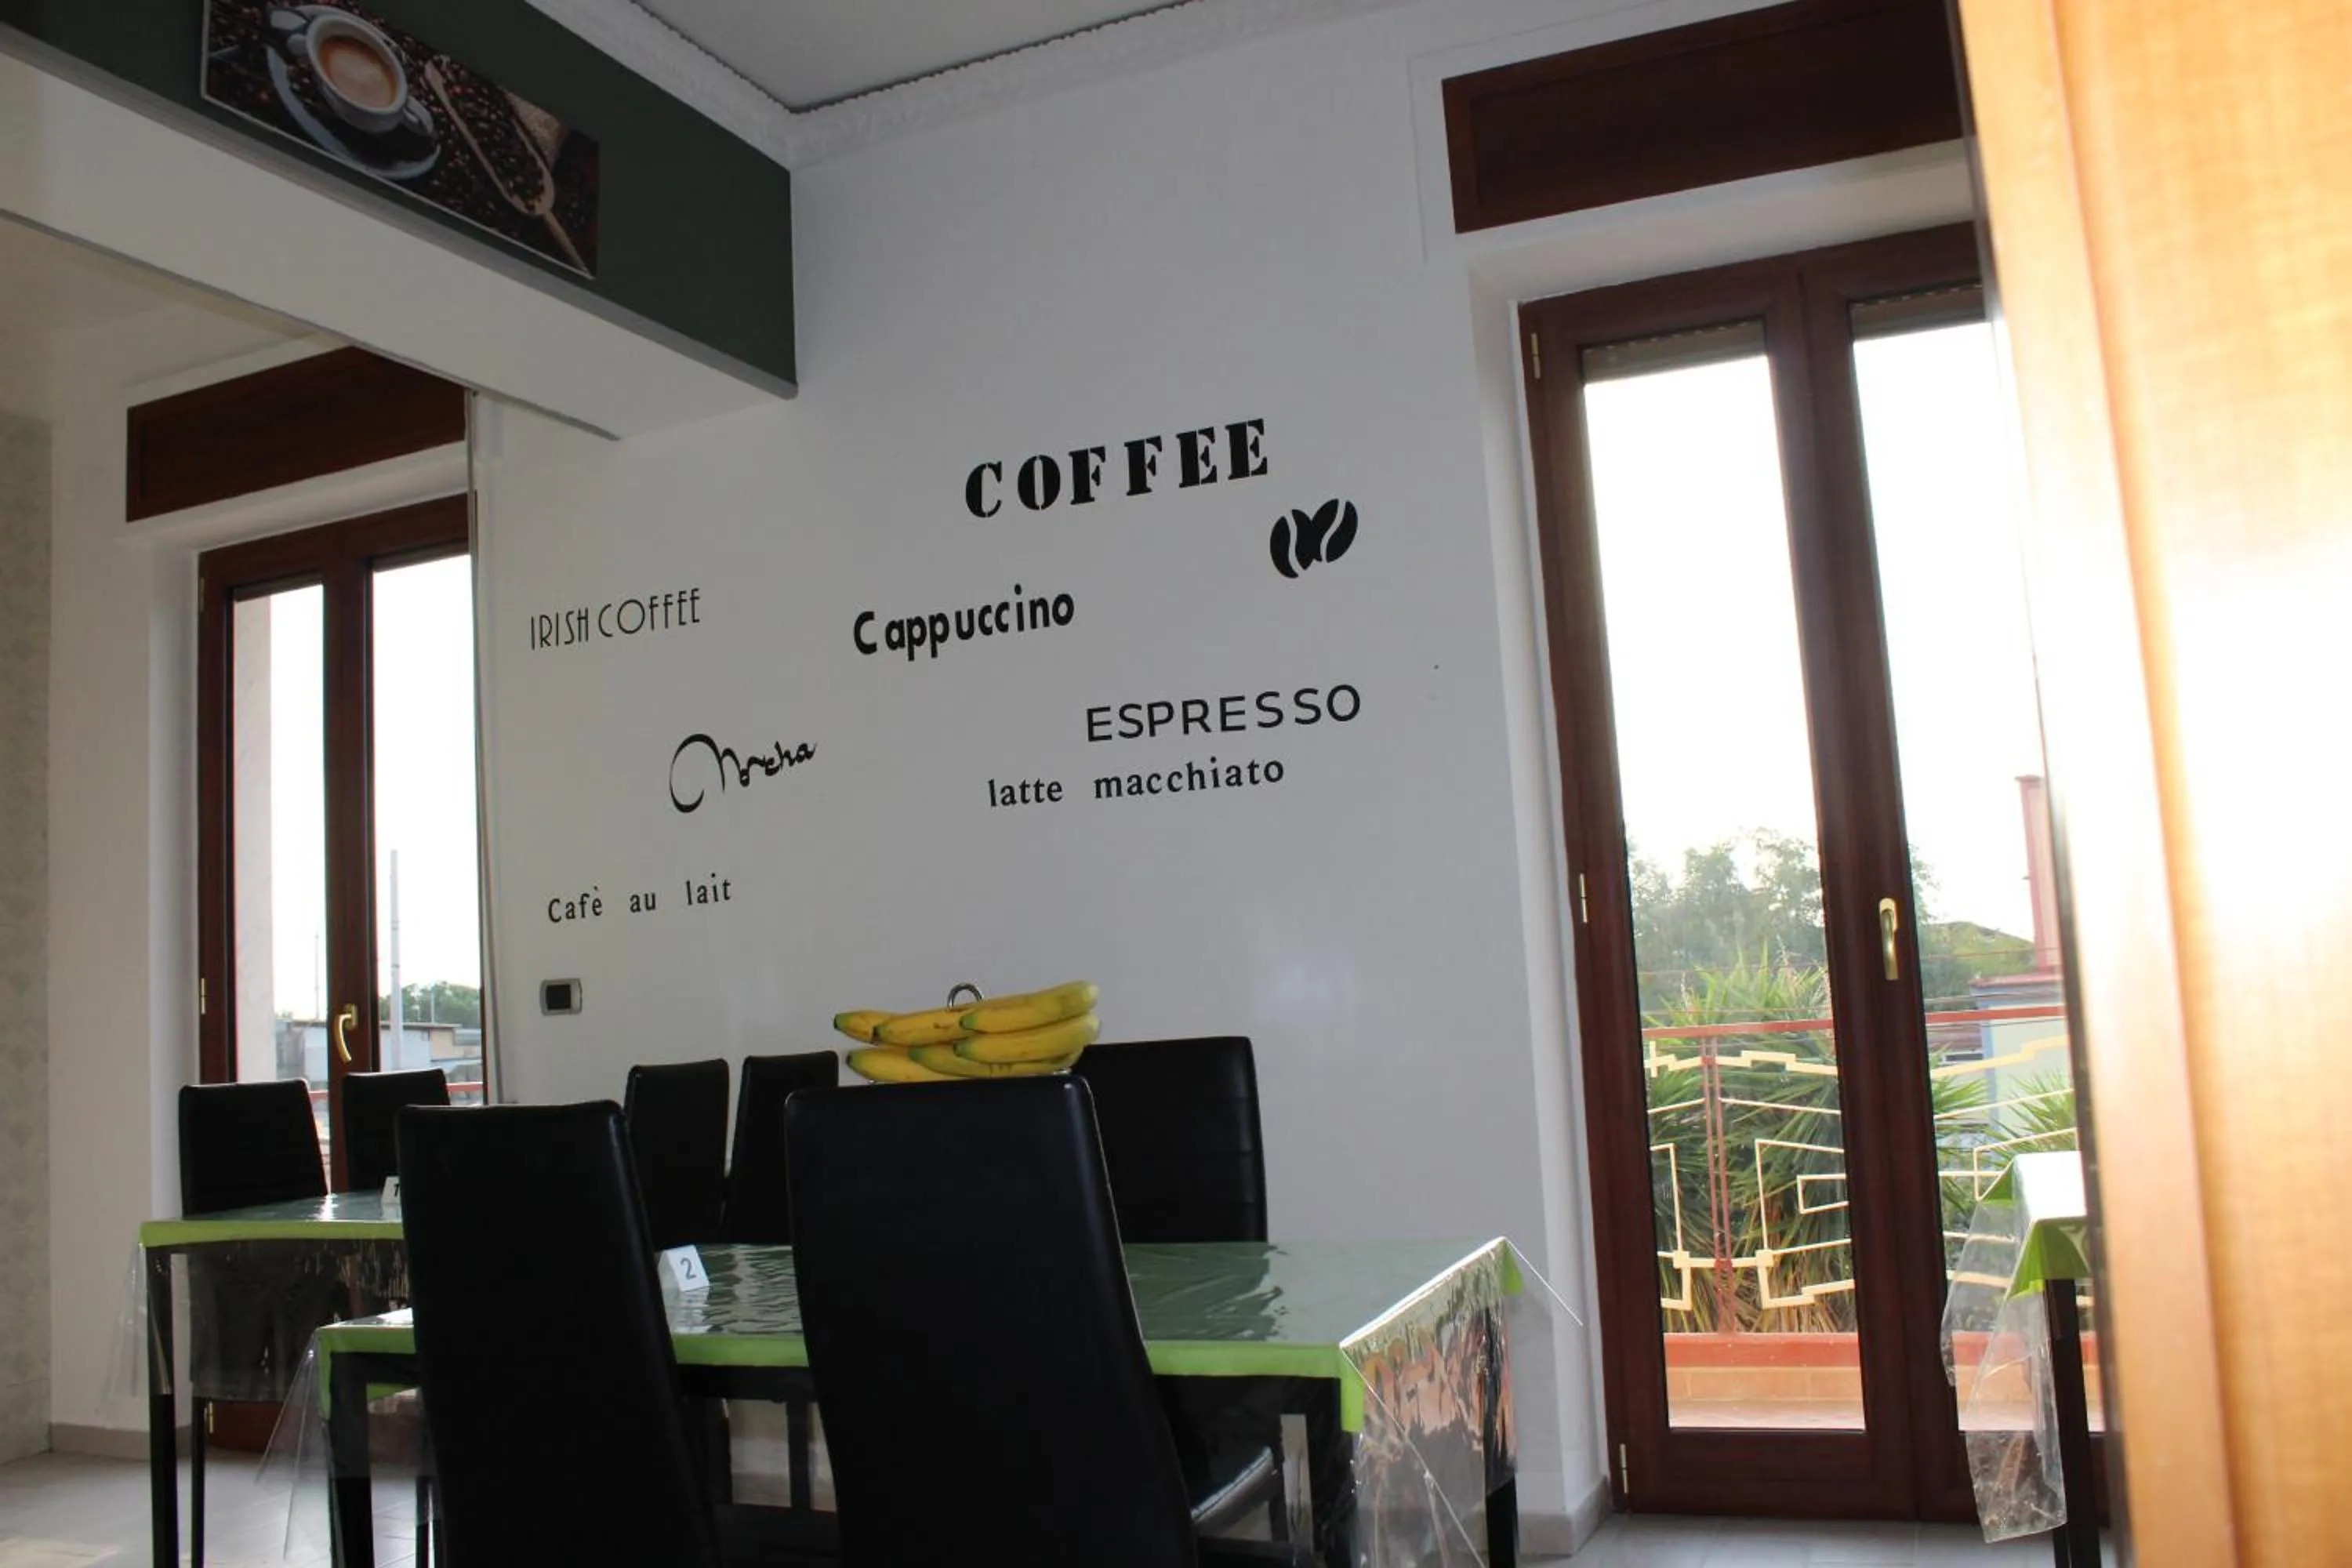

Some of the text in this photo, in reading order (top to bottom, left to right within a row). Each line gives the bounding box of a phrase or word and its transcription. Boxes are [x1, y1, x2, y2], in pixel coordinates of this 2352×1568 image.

[964, 418, 1269, 519] COFFEE
[531, 587, 701, 651] IRISH COFFEE
[853, 583, 1076, 663] Cappuccino
[1086, 684, 1361, 743] ESPRESSO
[987, 755, 1285, 808] latte macchiato
[629, 892, 657, 913] au
[685, 872, 731, 906] lait
[680, 1257, 697, 1280] 2
